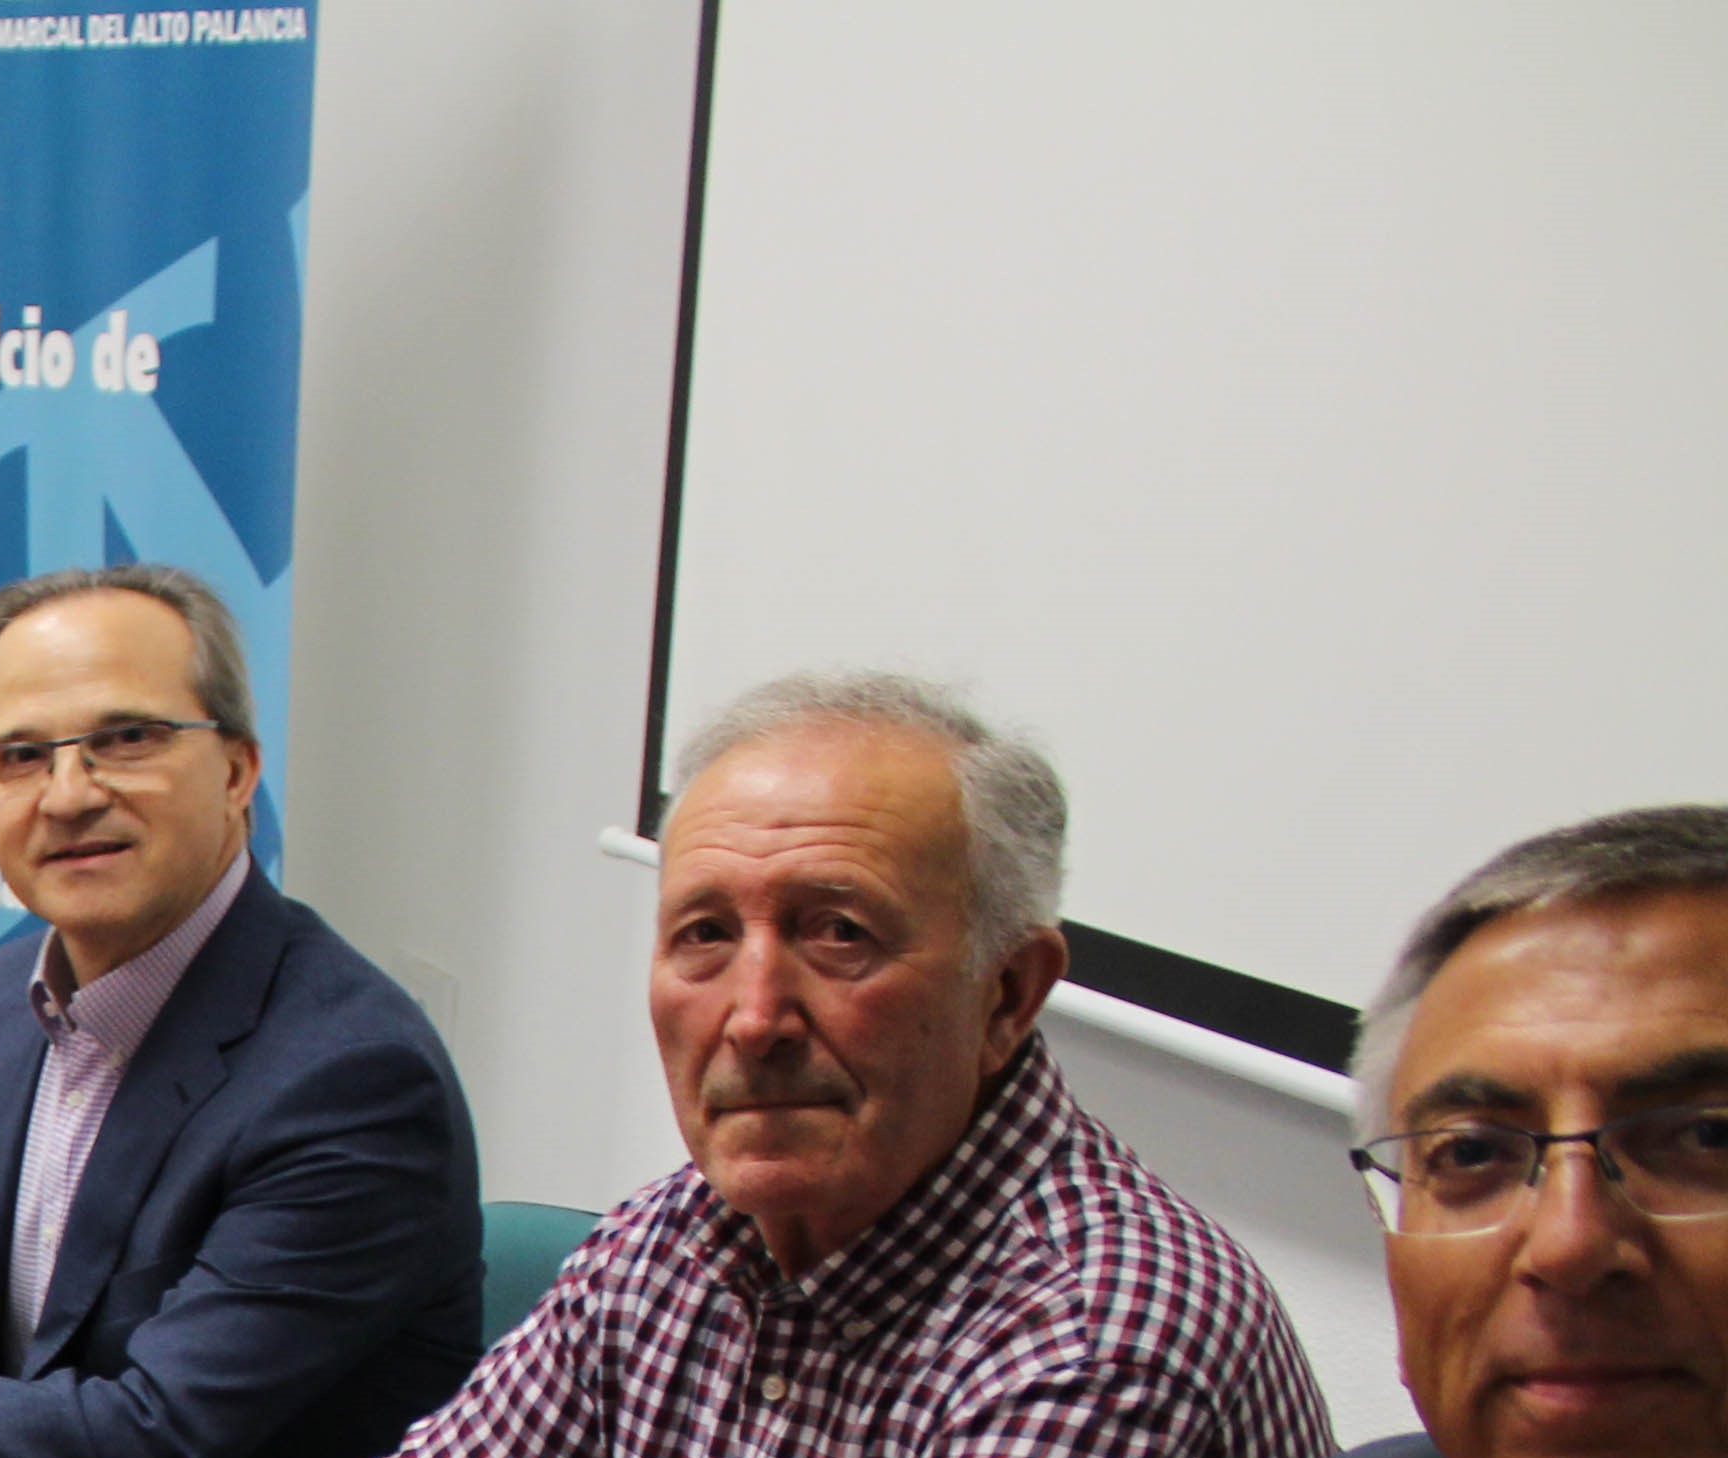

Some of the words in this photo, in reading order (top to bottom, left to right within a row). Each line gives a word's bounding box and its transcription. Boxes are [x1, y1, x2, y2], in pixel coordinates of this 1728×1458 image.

[87, 12, 129, 44] DEL
[130, 11, 190, 43] ALTO
[193, 7, 307, 42] PALANCIA
[92, 309, 161, 393] de
